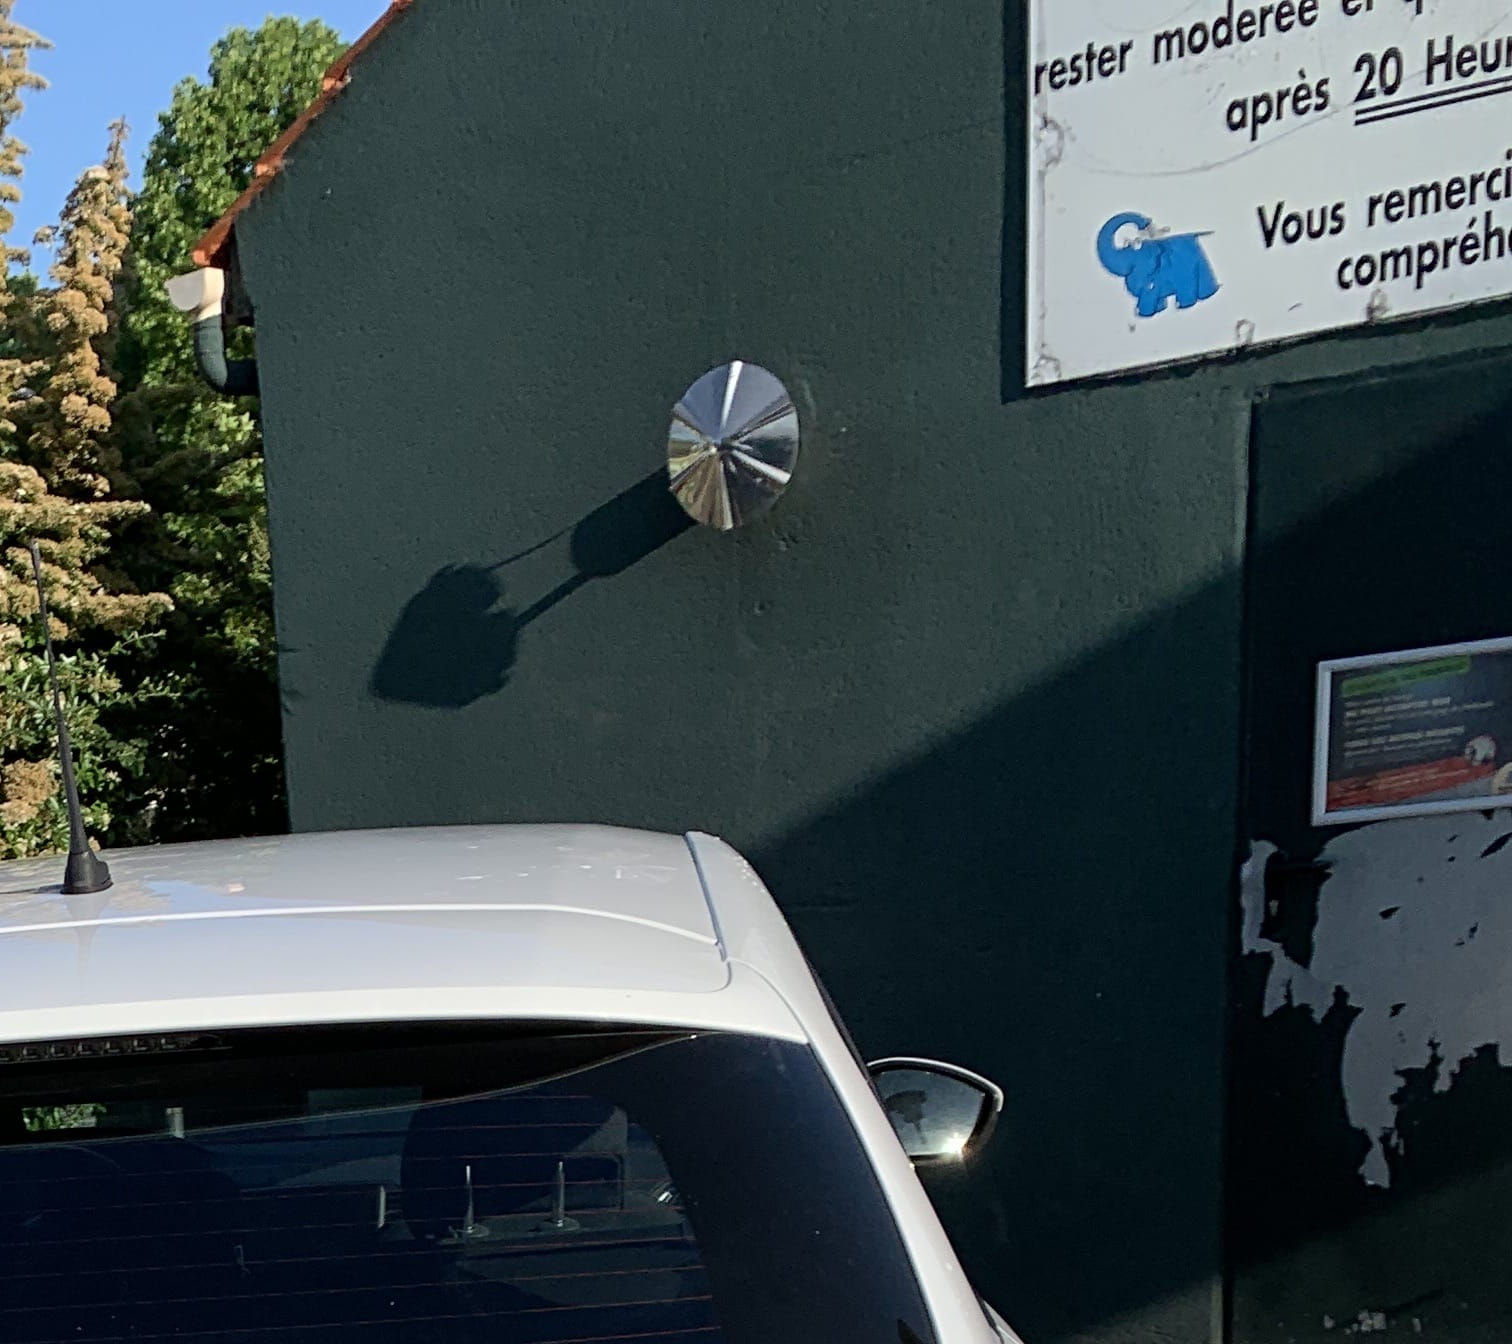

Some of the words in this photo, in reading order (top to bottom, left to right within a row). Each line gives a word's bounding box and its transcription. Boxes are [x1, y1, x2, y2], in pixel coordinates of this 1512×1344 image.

[1033, 38, 1134, 96] rester
[1225, 69, 1331, 142] après
[1353, 46, 1404, 101] 20
[1256, 199, 1346, 249] Vous
[1337, 210, 1512, 291] compréh
